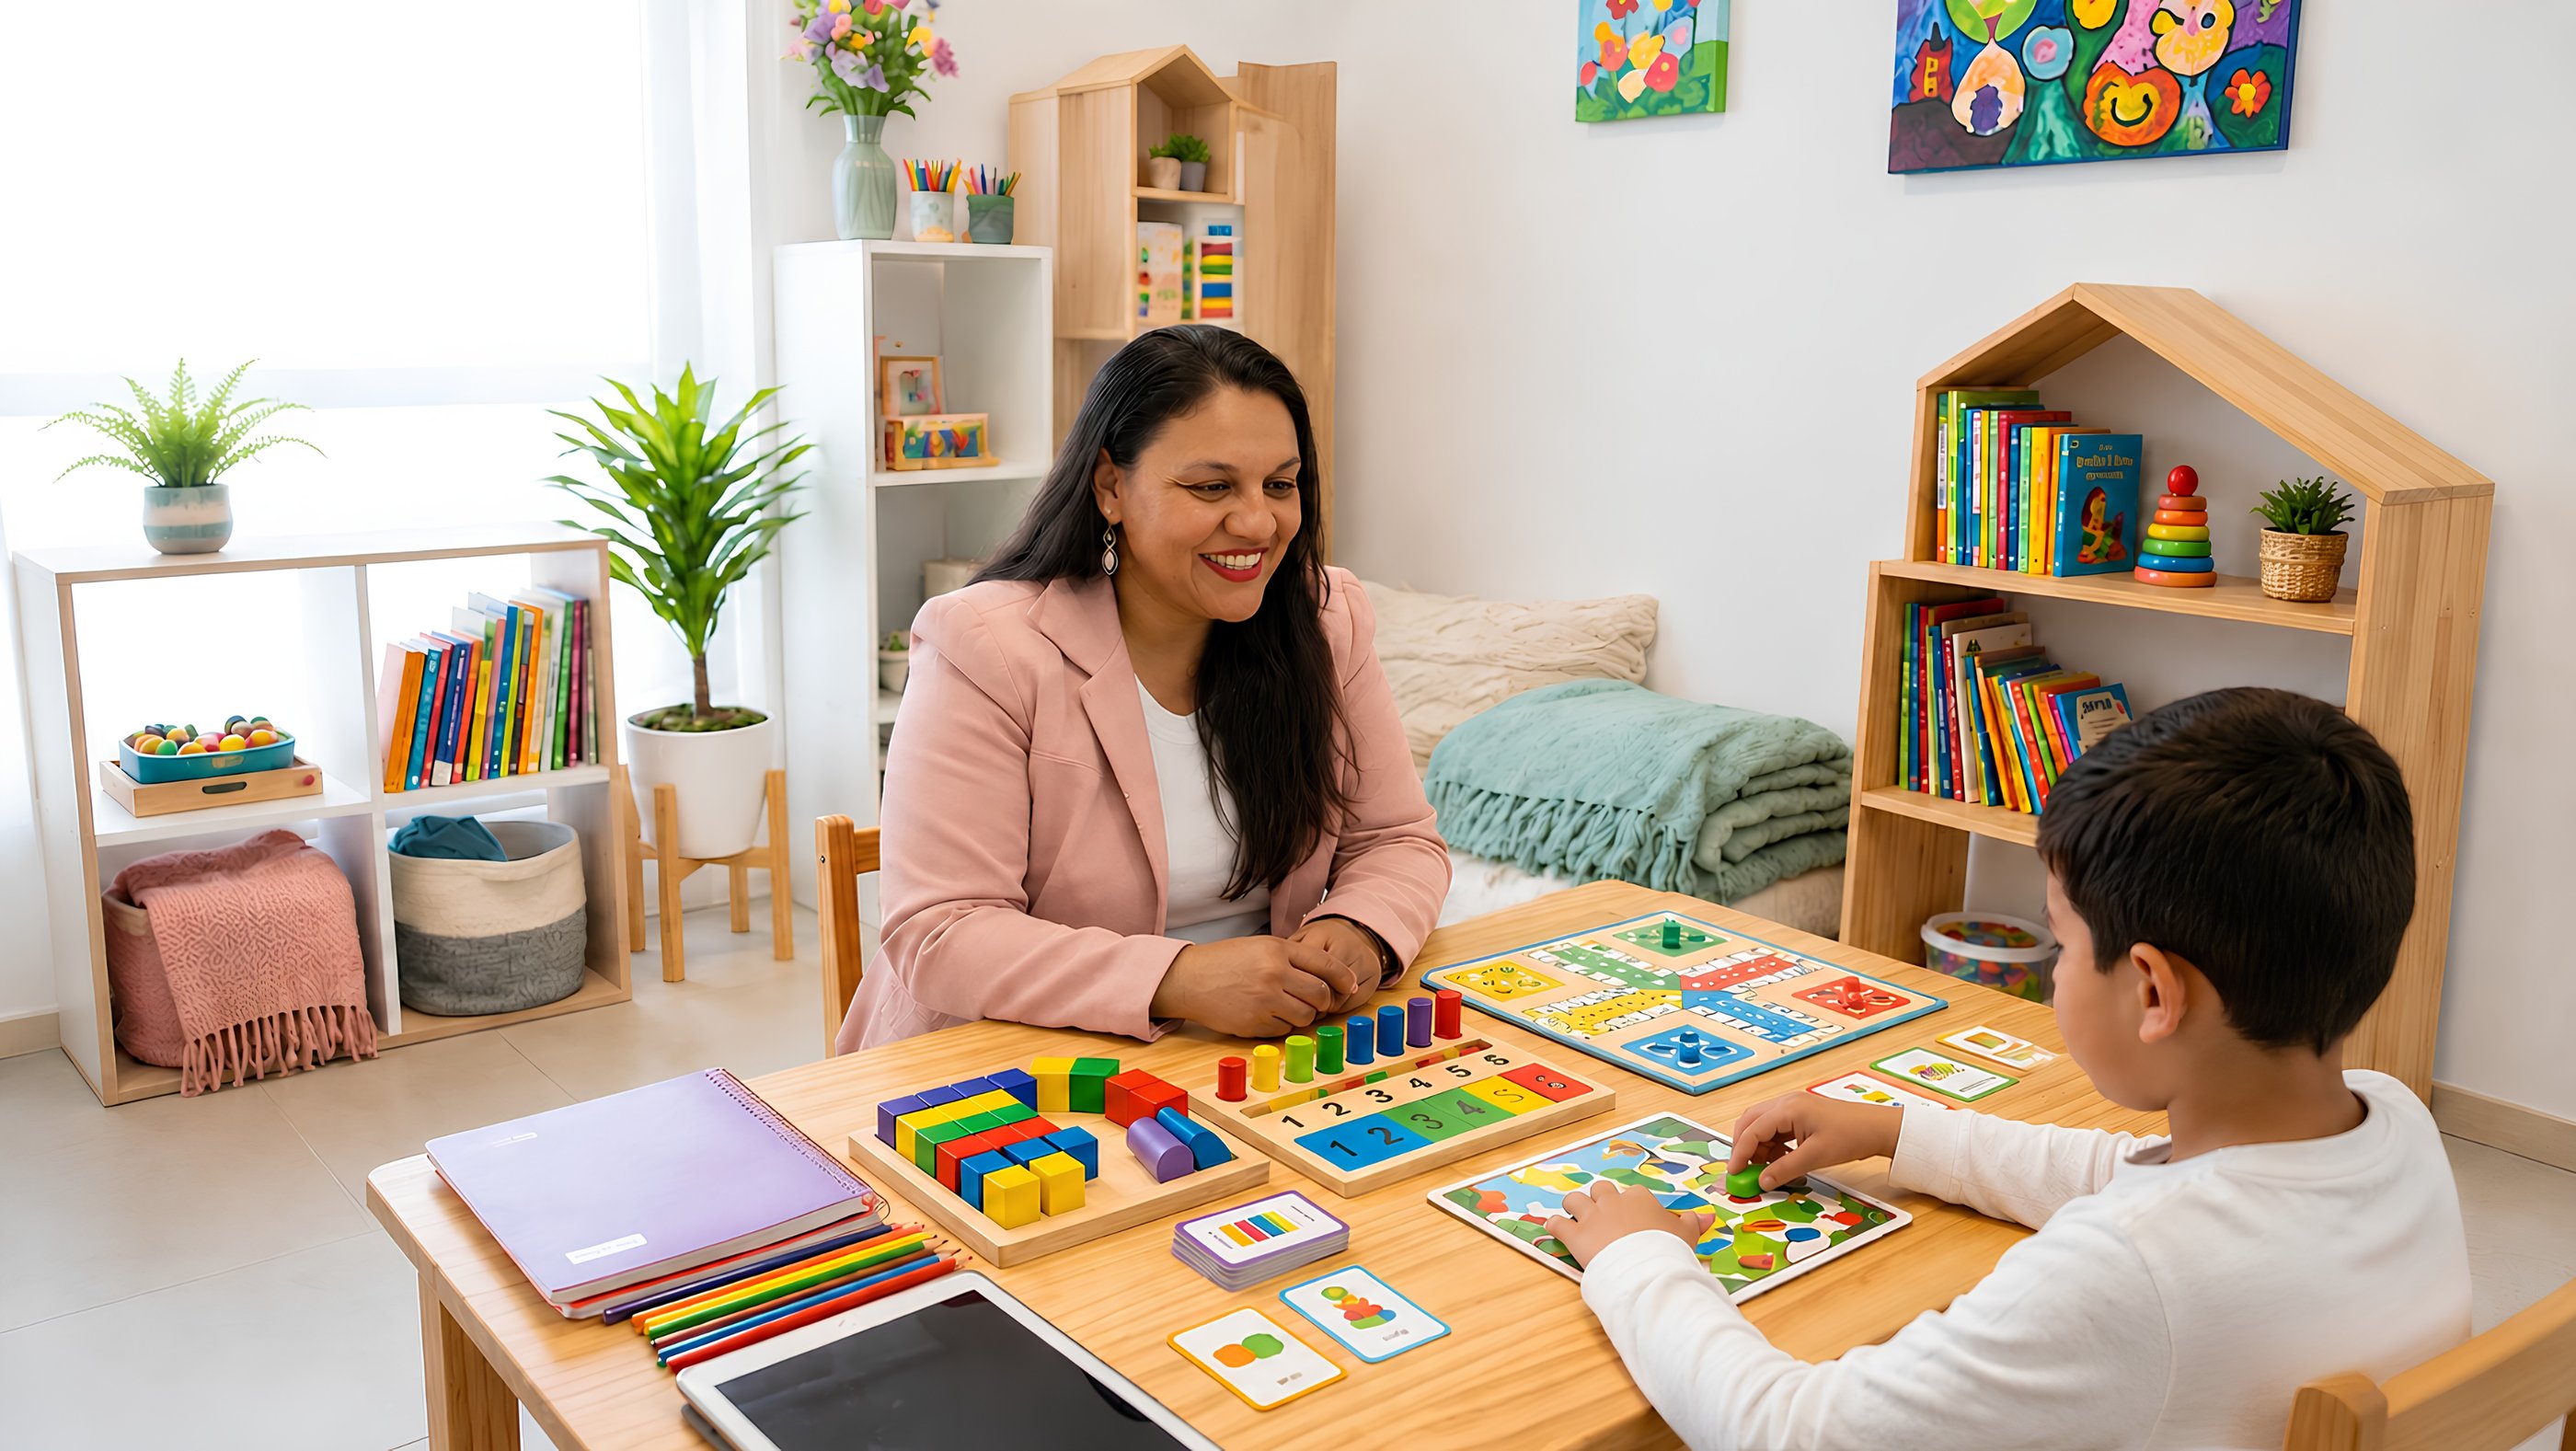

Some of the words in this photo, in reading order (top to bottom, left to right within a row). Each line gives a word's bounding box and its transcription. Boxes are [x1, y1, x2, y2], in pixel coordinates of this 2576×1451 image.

[1282, 1115, 1305, 1128] 1
[1322, 1102, 1351, 1116] 2
[1365, 1088, 1394, 1103] 3
[1409, 1077, 1432, 1088] 4
[1445, 1065, 1472, 1077] 5
[1329, 1140, 1358, 1157] 1
[1367, 1127, 1404, 1145] 2
[1410, 1113, 1443, 1130] 3
[1456, 1100, 1486, 1115] 4
